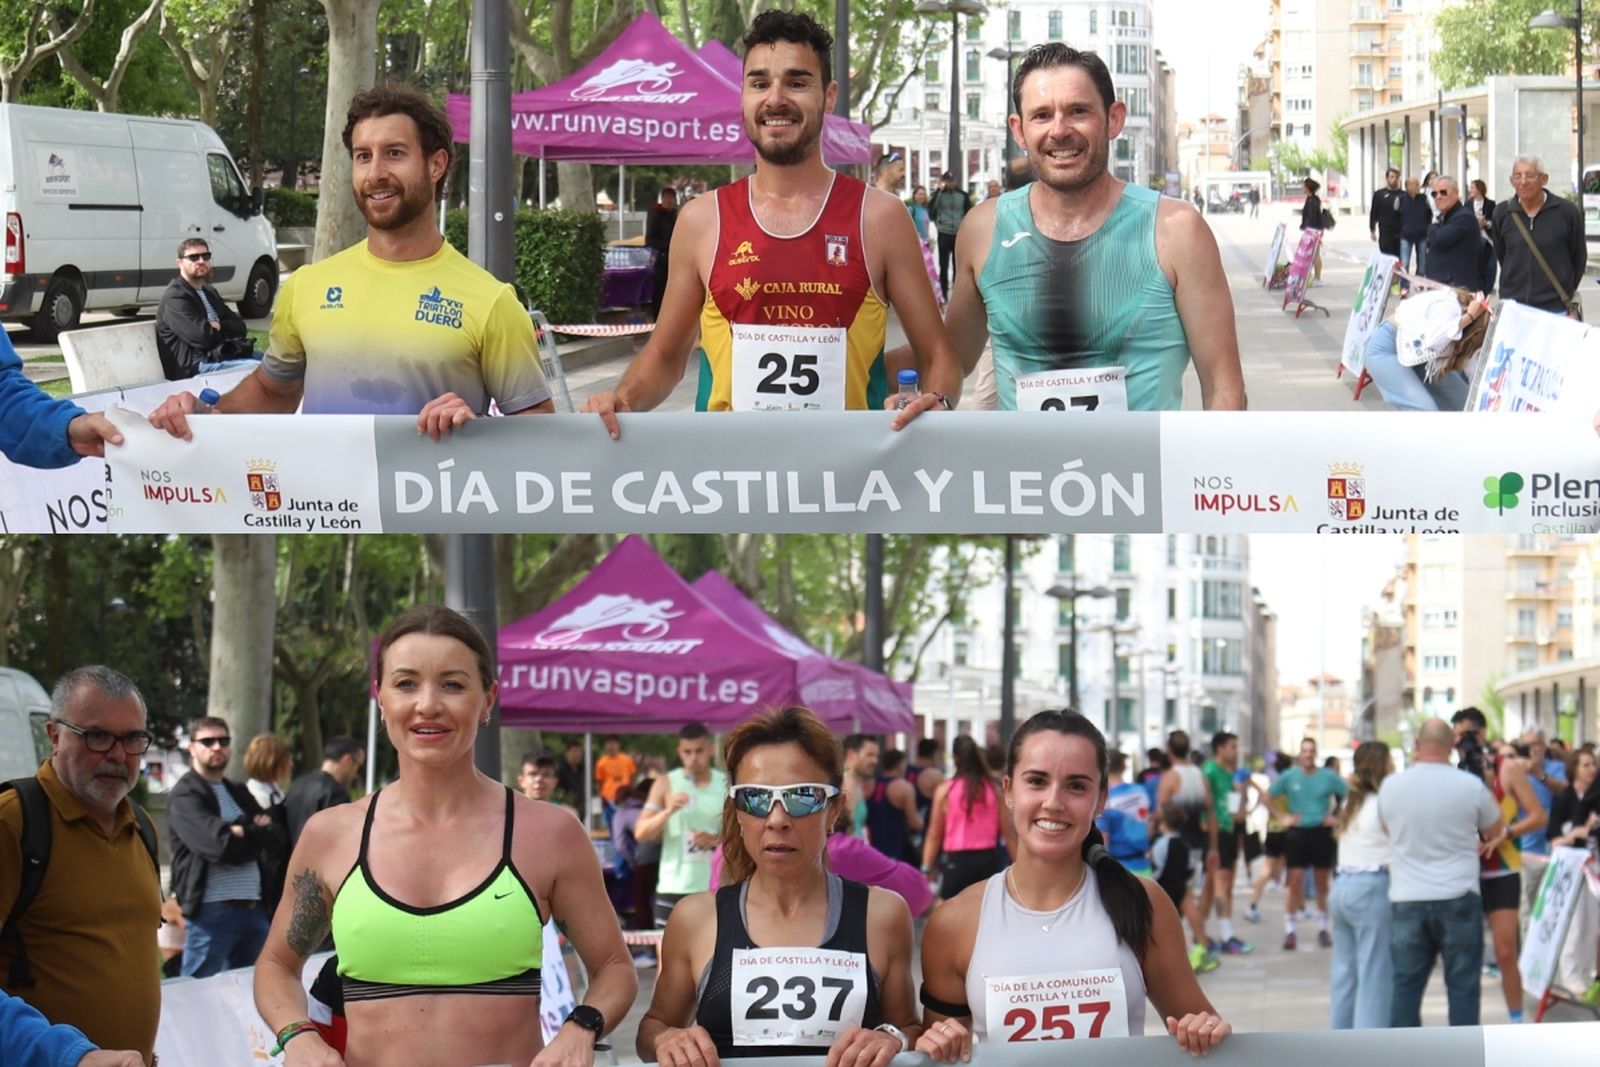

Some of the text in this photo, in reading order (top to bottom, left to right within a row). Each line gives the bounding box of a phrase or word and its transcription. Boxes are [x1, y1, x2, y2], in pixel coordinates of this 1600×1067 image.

[763, 282, 843, 295] CAJA RURAL
[418, 300, 463, 319] TRIATLON
[762, 305, 814, 319] VINO
[414, 310, 463, 329] DUERO
[754, 333, 766, 341] DE
[768, 334, 809, 343] CASTILLA
[809, 335, 817, 343] Y
[818, 334, 840, 344] LEÓN
[756, 352, 820, 396] 25
[1035, 379, 1044, 388] DE
[1046, 377, 1085, 387] CASTILLA
[1086, 376, 1093, 384] Y
[1094, 374, 1119, 383] LEÓN
[140, 469, 171, 483] NOS
[1193, 476, 1233, 490] NOS
[394, 457, 1145, 517] DÍA DE CASTILLA Y LEÓN
[1531, 472, 1600, 500] Plen
[143, 485, 227, 505] IMPULSA
[46, 489, 107, 534] NOS
[287, 498, 359, 513] Junta de
[1194, 494, 1299, 516] IMPULSA
[1371, 505, 1460, 521] Junta de
[1531, 500, 1600, 517] inclusi
[243, 514, 362, 532] Castilla y León
[1532, 522, 1587, 534] Castilla
[497, 664, 760, 705] .runvasport.es
[739, 956, 859, 969] DÍA DE CASTILLA Y LEÓN
[1013, 982, 1028, 992] DE
[1030, 981, 1044, 990] LA
[745, 975, 854, 1022] 237
[1009, 988, 1101, 1004] CASTILLA Y LEÓN
[1003, 1001, 1111, 1042] 257
